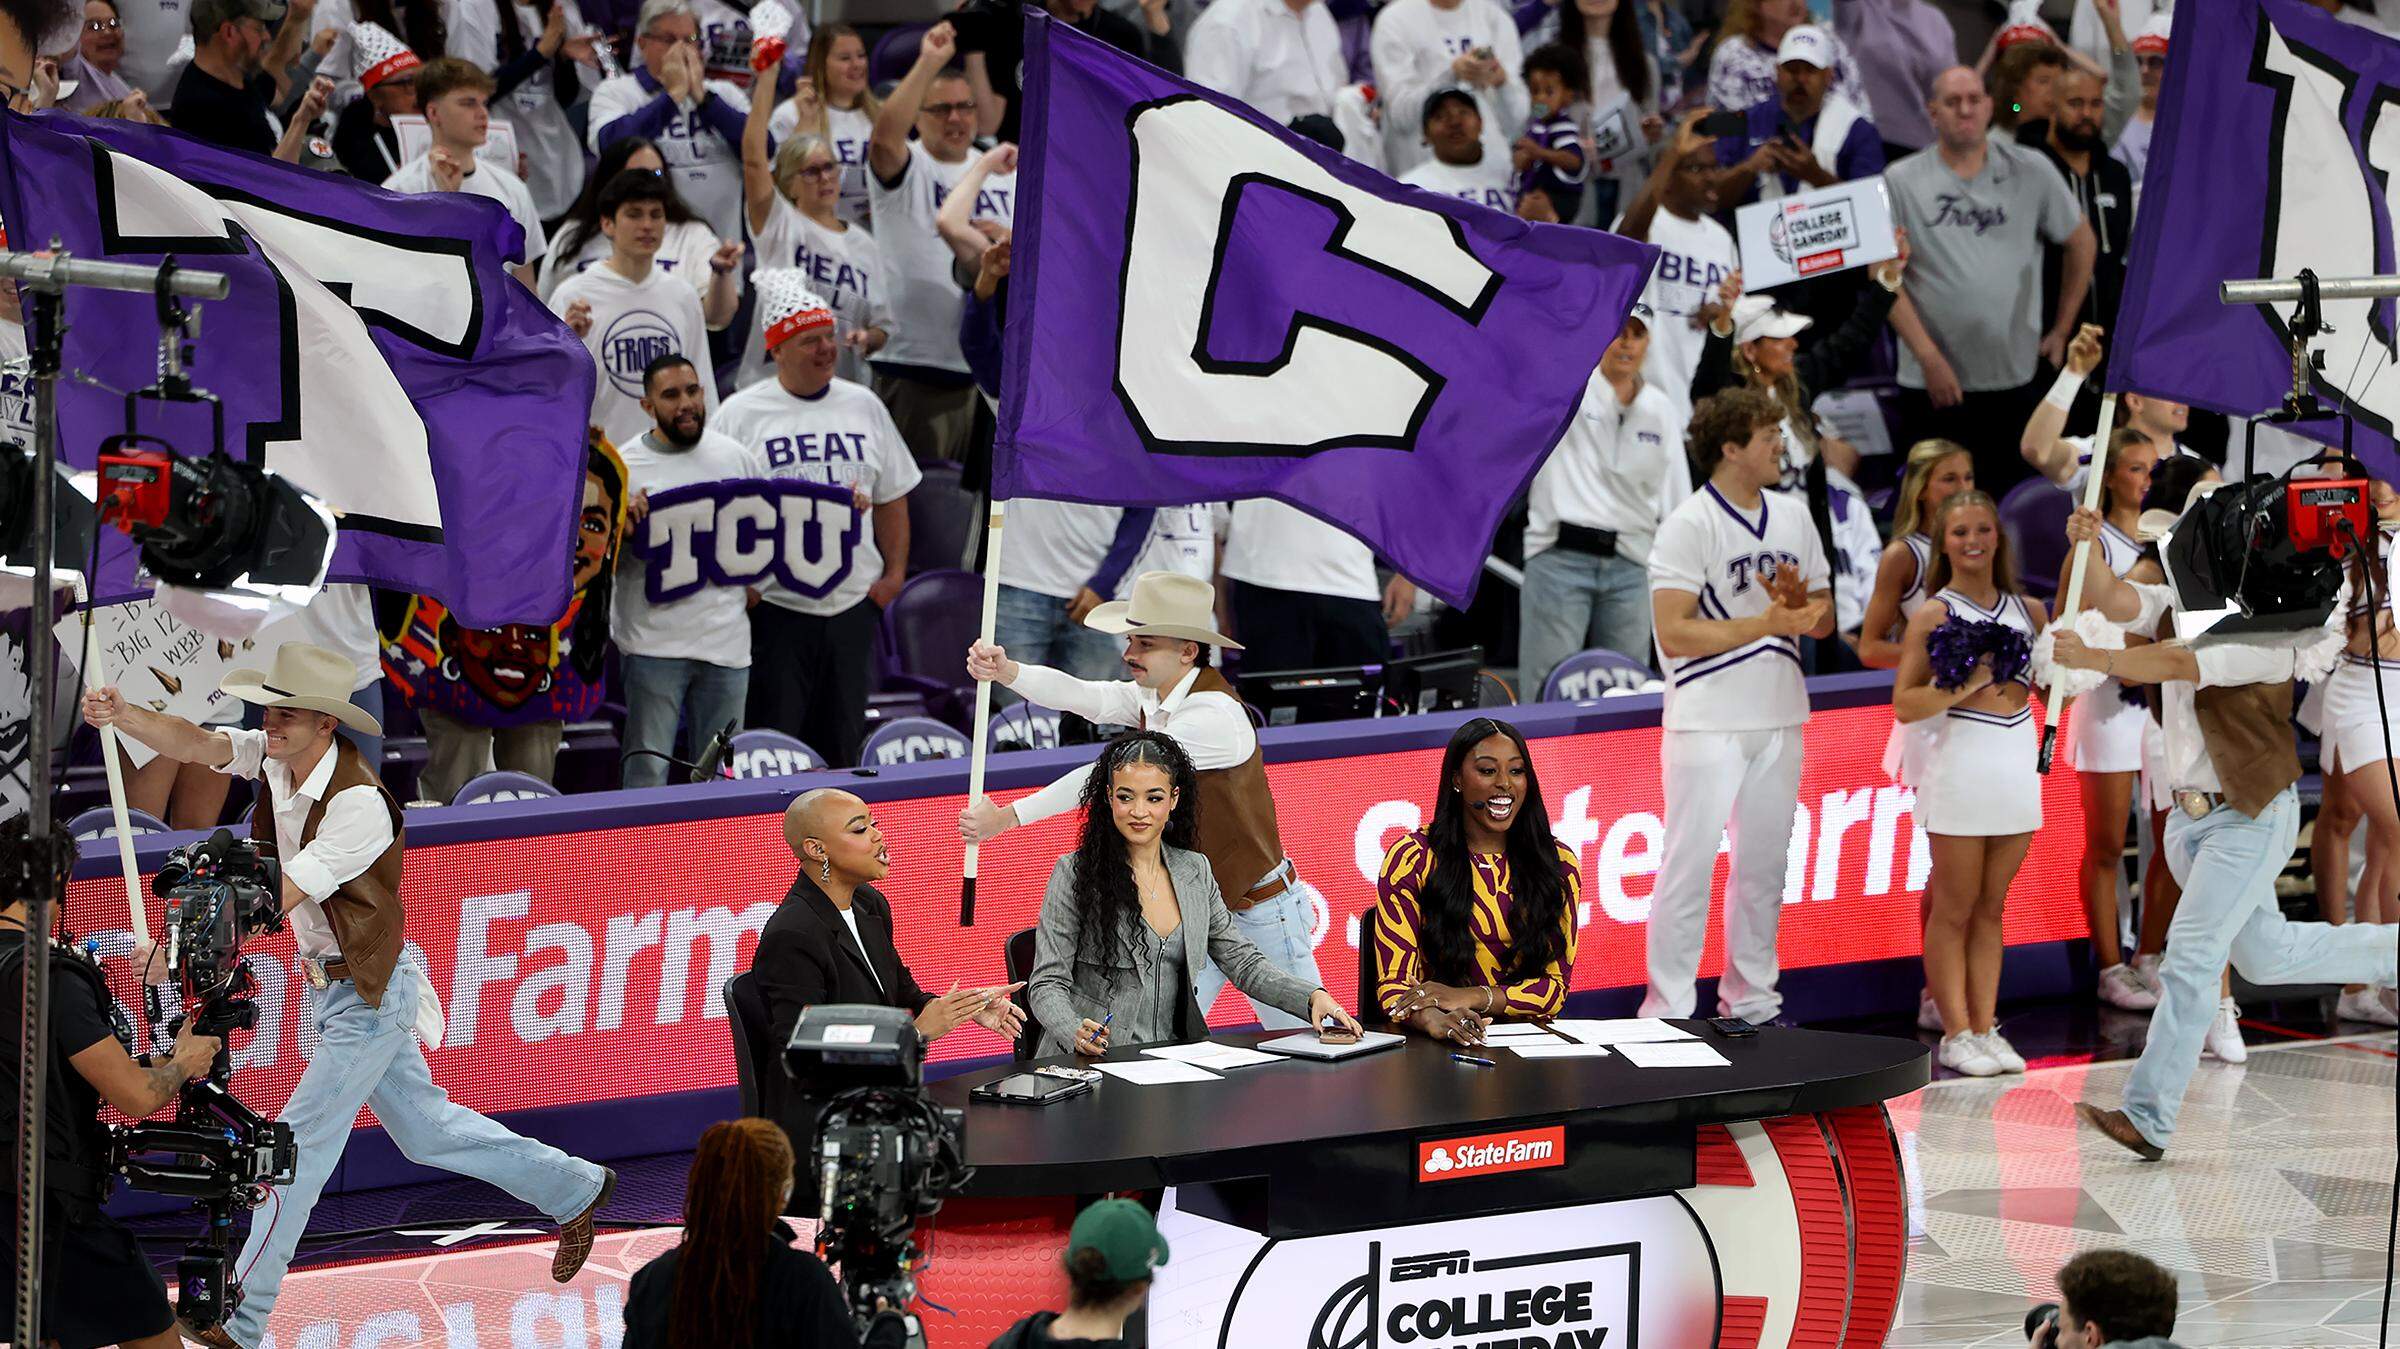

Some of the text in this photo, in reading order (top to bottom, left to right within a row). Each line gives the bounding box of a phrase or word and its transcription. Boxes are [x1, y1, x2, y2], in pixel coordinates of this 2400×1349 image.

[1789, 209, 1843, 234] COLLEGE
[1792, 226, 1849, 250] GAMEDAY
[1112, 95, 1506, 458] C
[765, 432, 866, 469] BEAT
[649, 494, 852, 593] TCU
[114, 629, 152, 665] BIG
[154, 610, 181, 637] 12
[162, 629, 204, 665] WBB
[1390, 1249, 1471, 1283] ESPN
[1387, 1281, 1593, 1344] COLLEGE
